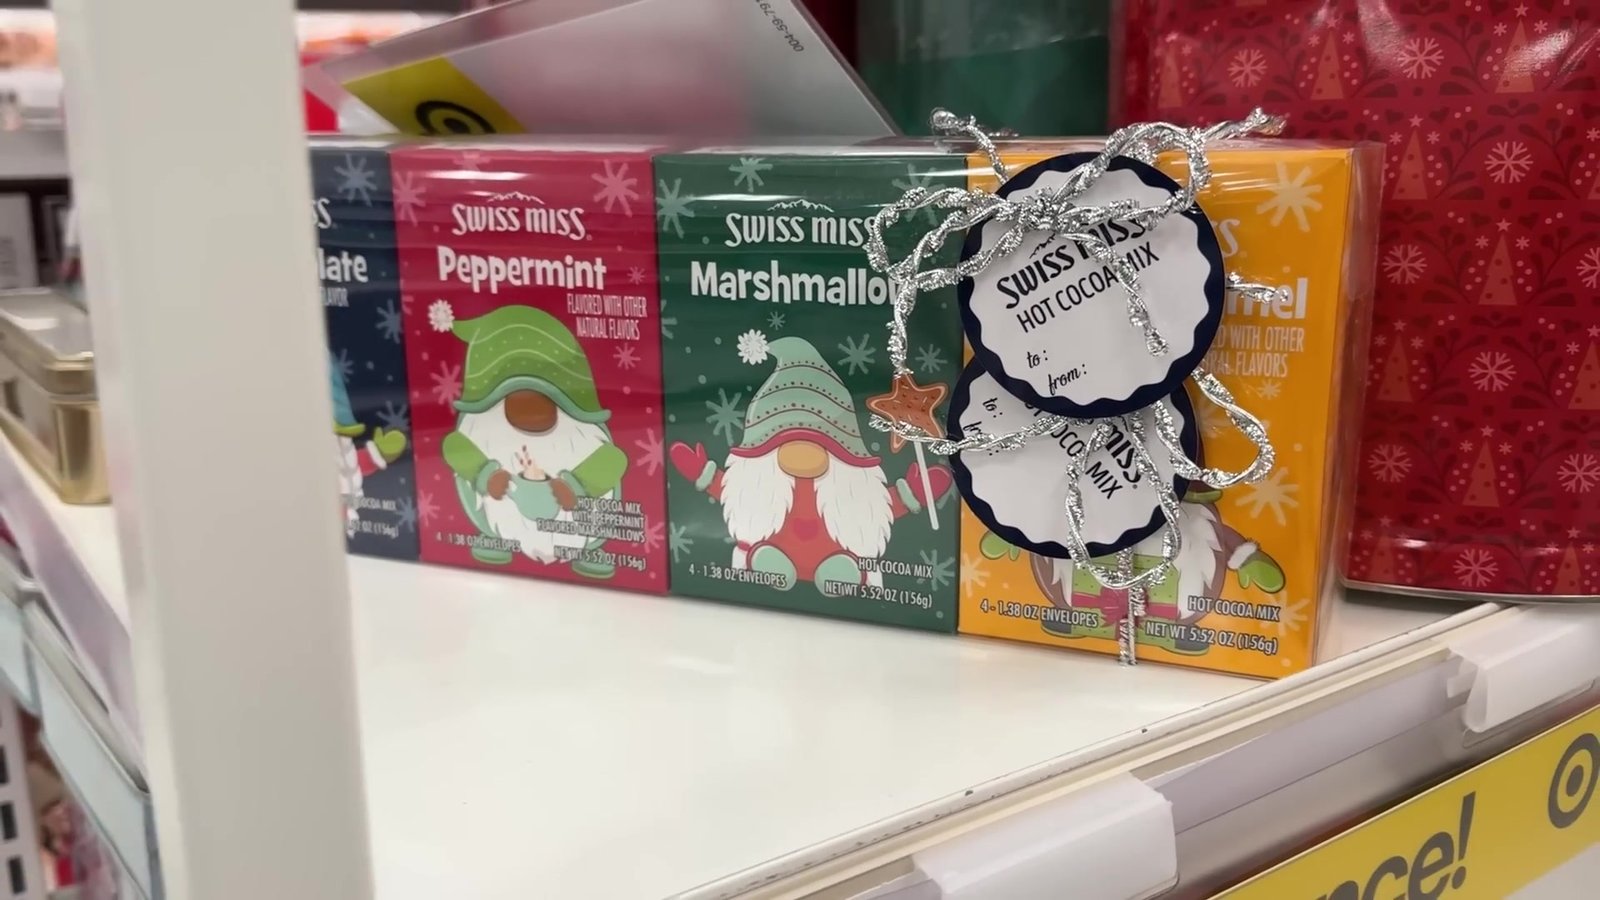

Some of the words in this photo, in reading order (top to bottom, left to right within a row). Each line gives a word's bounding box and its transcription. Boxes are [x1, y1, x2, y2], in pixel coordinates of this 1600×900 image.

[451, 203, 520, 235] SWISS
[724, 213, 805, 248] SWISS
[437, 246, 607, 294] Peppermint
[997, 244, 1075, 309] SWISS
[566, 293, 603, 315] FLAVORED
[603, 295, 622, 316] WITH
[623, 296, 648, 317] OTHER
[1016, 296, 1057, 333] HOT
[1055, 265, 1119, 312] COCOA
[576, 317, 608, 338] NATURAL
[609, 318, 640, 340] FLAVORS
[1231, 325, 1261, 350] WITH
[1264, 327, 1305, 352] OTHER
[1026, 350, 1049, 369] to:
[1235, 351, 1289, 378] FLAVORS
[1048, 364, 1088, 395] from:
[1085, 461, 1123, 500] MIX
[578, 497, 594, 509] HOT
[597, 499, 623, 512] COCOA
[537, 520, 576, 534] FLAVORED
[578, 523, 646, 543] MARSHMALLOWS
[573, 511, 592, 523] WITH
[592, 512, 645, 528] PEPPERMINT
[480, 537, 521, 553] ENVELOPES
[605, 552, 616, 565] OZ
[618, 554, 646, 571] (156g)
[858, 558, 877, 572] HOT
[880, 560, 911, 576] COCOA
[913, 564, 932, 579] MIX
[688, 563, 695, 576] 4
[703, 565, 722, 579] 1.38
[724, 567, 737, 581] OZ
[738, 570, 787, 588] ENVELOPES
[825, 581, 841, 594] NET
[842, 583, 858, 597] WT
[860, 585, 881, 600] 5.52
[884, 588, 897, 602] OZ
[900, 590, 933, 609] (156g)
[1188, 596, 1212, 612] HOT
[1215, 600, 1253, 617] COCOA
[1256, 605, 1280, 621] MIX
[980, 599, 988, 612] 4
[998, 601, 1020, 616] 1.38
[1024, 605, 1039, 619] OZ
[1041, 607, 1098, 627] ENVELOPES
[1146, 621, 1167, 637] NET
[1169, 624, 1186, 640] WT
[1189, 627, 1215, 644] 5.52
[1219, 631, 1235, 647] OZ
[1238, 634, 1278, 655] (156g)
